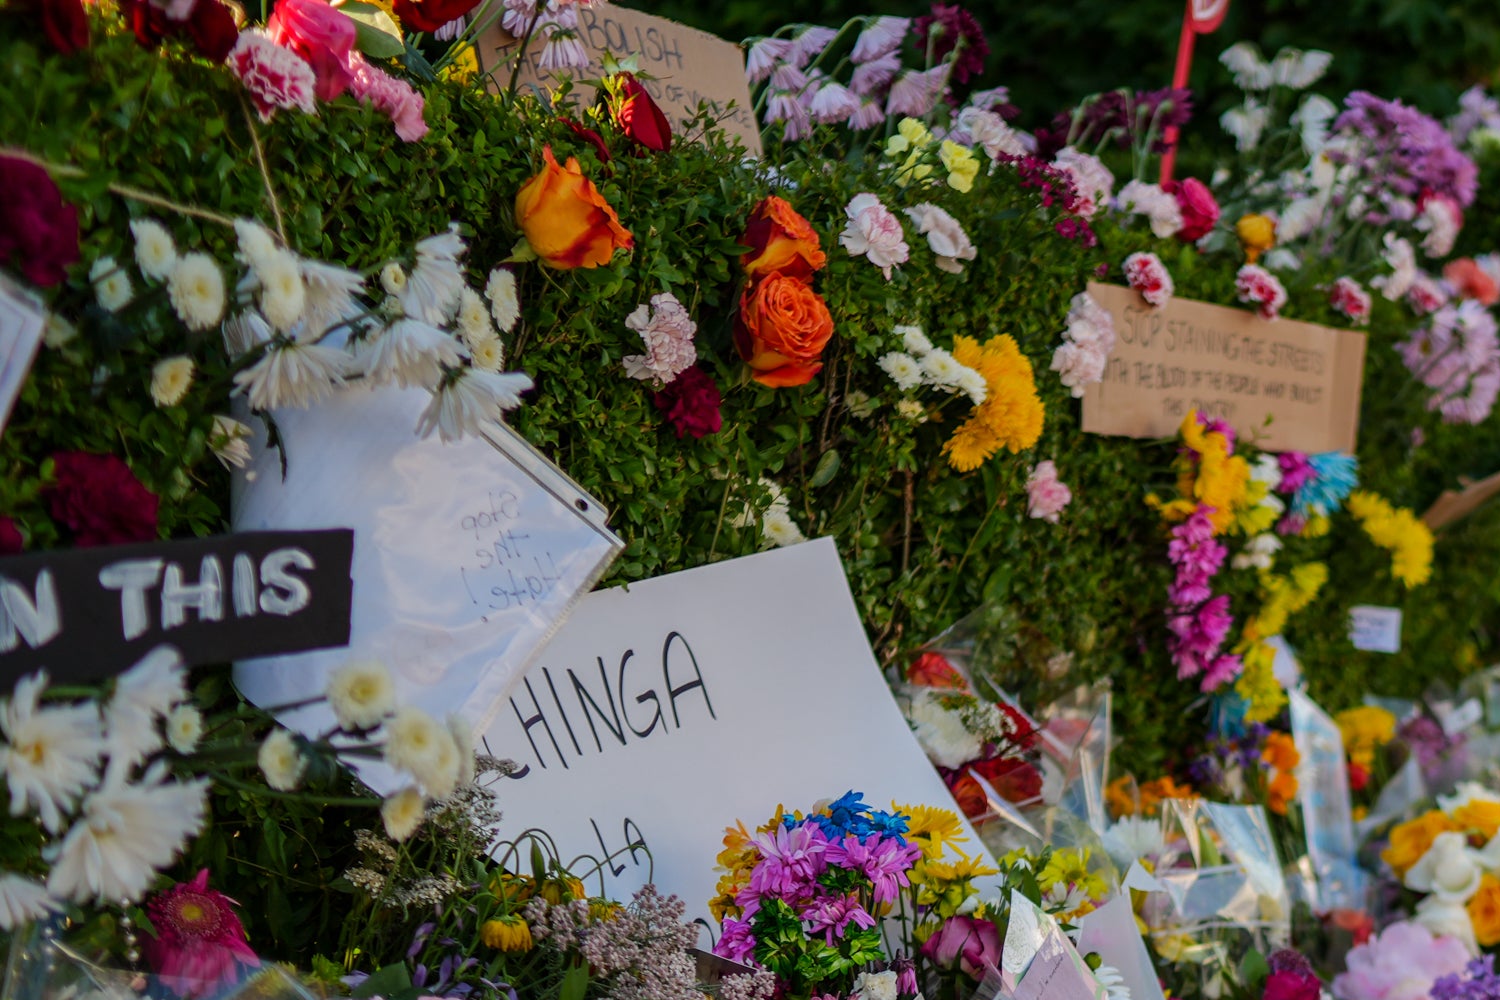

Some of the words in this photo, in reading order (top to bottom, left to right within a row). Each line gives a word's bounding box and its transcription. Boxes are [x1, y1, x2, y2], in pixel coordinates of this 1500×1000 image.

[1120, 304, 1162, 348] STOP
[1164, 319, 1238, 362] STAINING
[1241, 336, 1266, 366] THE
[1269, 341, 1326, 377] STREETS
[98, 547, 317, 643] THIS
[589, 816, 650, 878] LA
